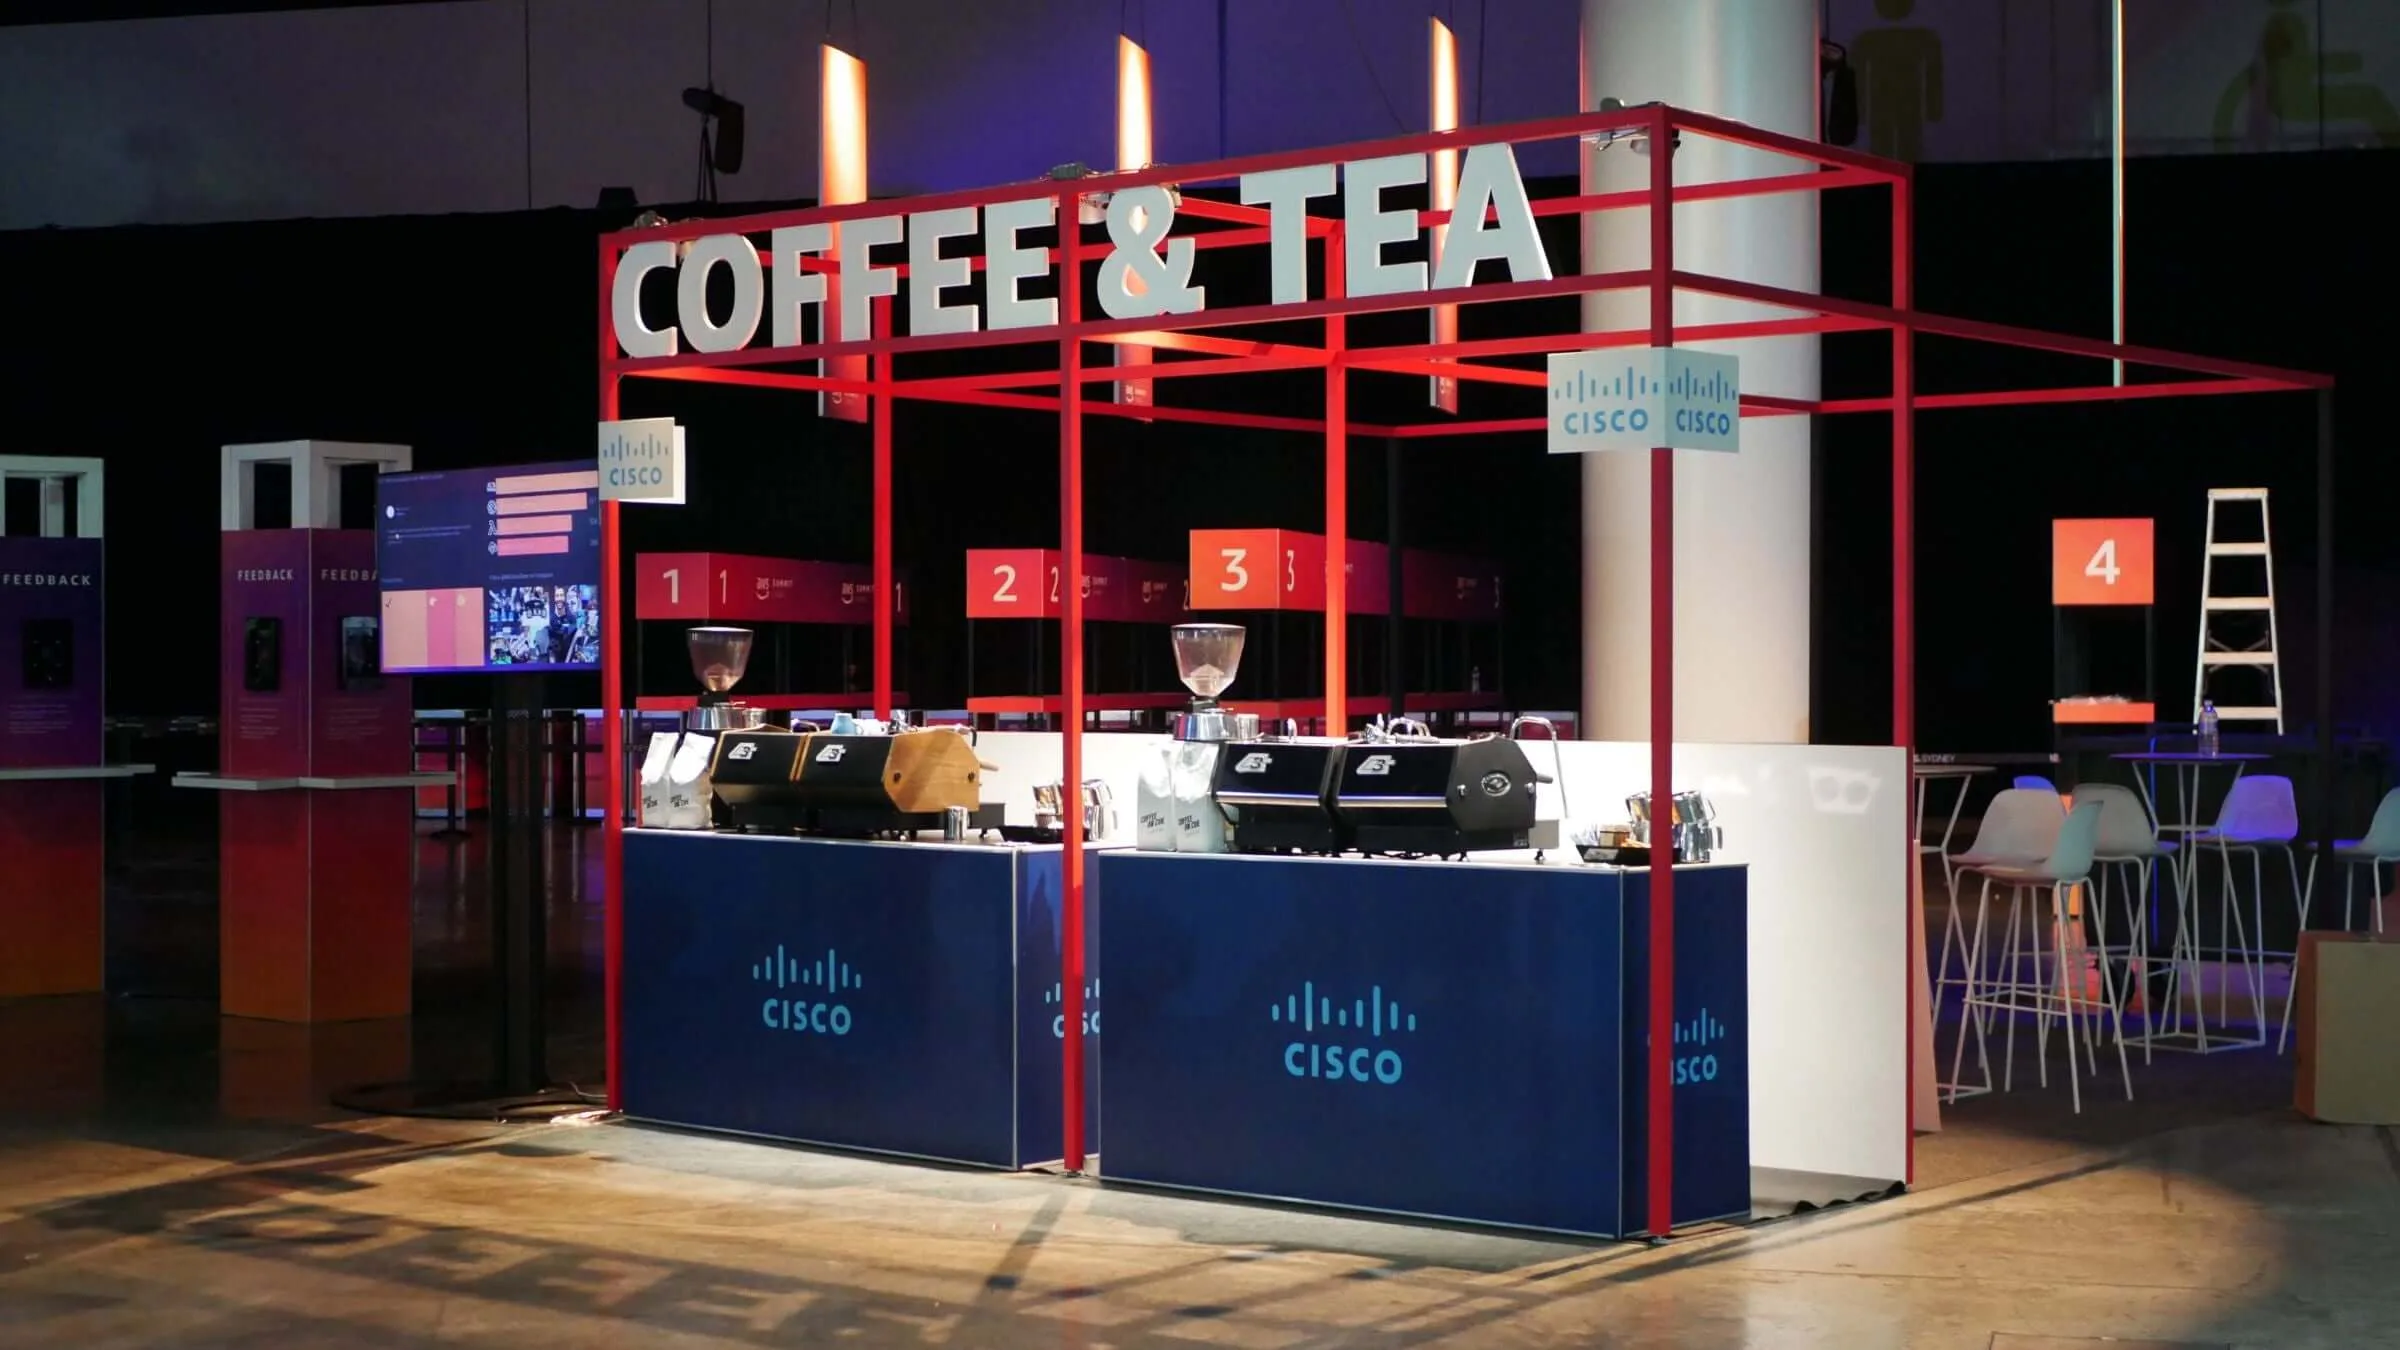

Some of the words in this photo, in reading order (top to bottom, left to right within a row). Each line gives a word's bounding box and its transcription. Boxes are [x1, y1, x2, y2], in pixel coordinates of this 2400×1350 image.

[612, 198, 1060, 359] COFFEE
[1096, 184, 1206, 320] &
[1240, 142, 1554, 306] TEA
[1563, 408, 1649, 436] CISCO
[1675, 408, 1731, 436] CISCO
[609, 466, 662, 487] CISCO
[3, 573, 91, 586] FEEDBACK
[237, 569, 294, 581] FEEDBACK
[1219, 548, 1249, 592] 3
[1287, 549, 1295, 592] 3
[2085, 539, 2121, 585] 4
[663, 568, 680, 604] 1
[719, 569, 728, 604] 1
[993, 564, 1018, 602] 2
[1050, 566, 1059, 603] 2
[762, 997, 852, 1036] CISCO
[1284, 1042, 1402, 1085] CISCO
